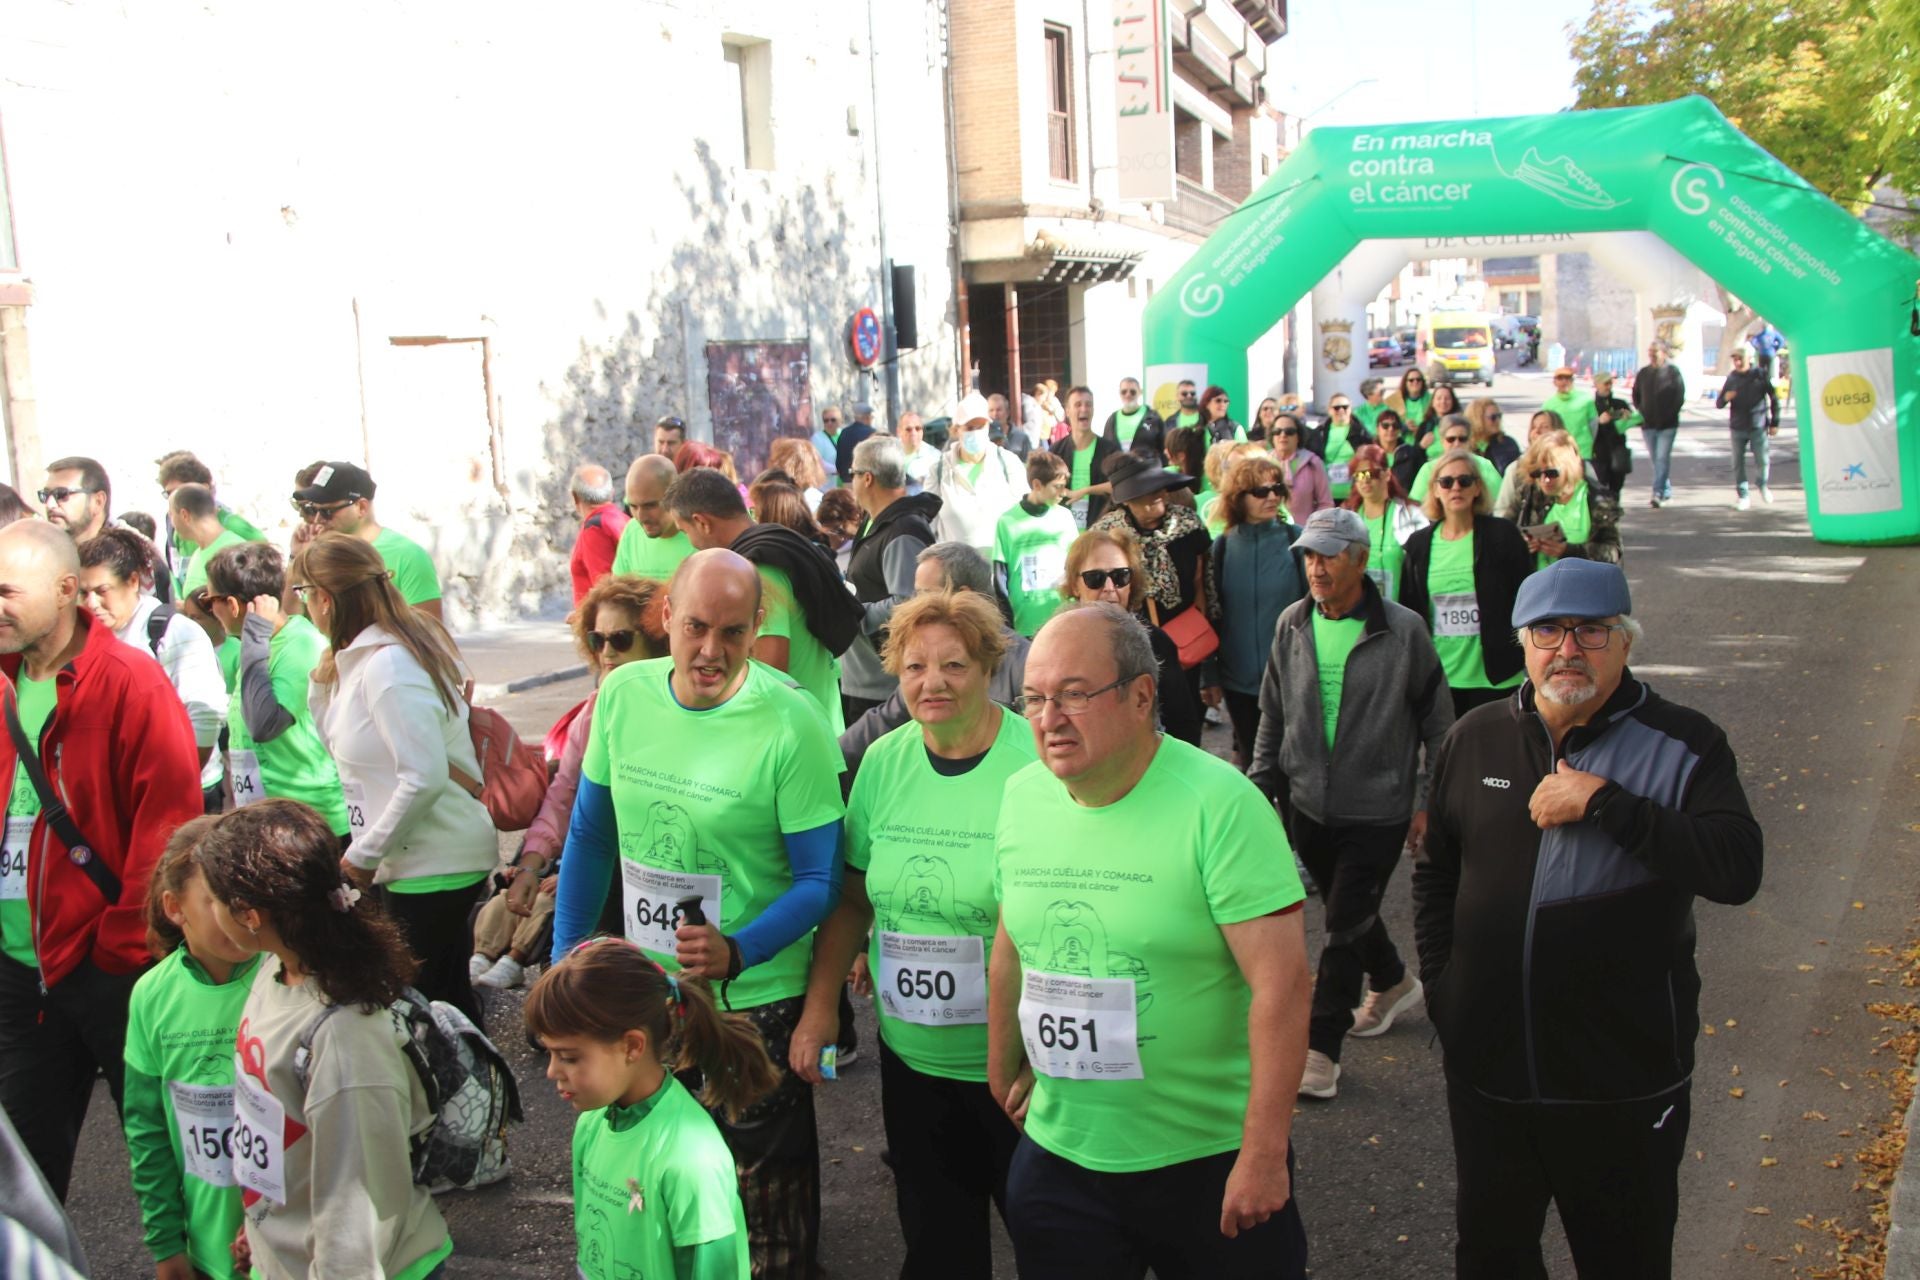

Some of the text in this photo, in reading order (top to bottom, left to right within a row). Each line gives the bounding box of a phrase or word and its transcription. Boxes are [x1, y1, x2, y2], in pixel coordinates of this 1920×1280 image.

[1352, 129, 1493, 151] En marcha
[1348, 154, 1435, 177] contra
[1349, 180, 1472, 204] el cáncer
[1707, 219, 1773, 275] en Segovia
[1718, 207, 1808, 280] contra el cáncer
[1729, 194, 1841, 286] asociación española
[1241, 233, 1286, 274] Segovia
[1824, 391, 1872, 407] uvesa
[1441, 608, 1481, 625] 1890
[626, 764, 658, 778] MARCHA
[700, 783, 743, 799] COMARCA
[654, 782, 678, 794] contra
[686, 790, 713, 803] cáncer
[945, 840, 971, 849] cáncer
[1020, 868, 1051, 877] MARCHA
[1052, 866, 1094, 878] CUÉLLAR
[1095, 870, 1101, 878] Y
[1102, 870, 1154, 884] COMARCA
[1022, 879, 1049, 888] marcha
[1050, 879, 1077, 890] contra
[1078, 881, 1088, 890] el
[1089, 882, 1120, 892] cáncer
[897, 967, 956, 1001] 650
[1038, 1013, 1098, 1053] 651
